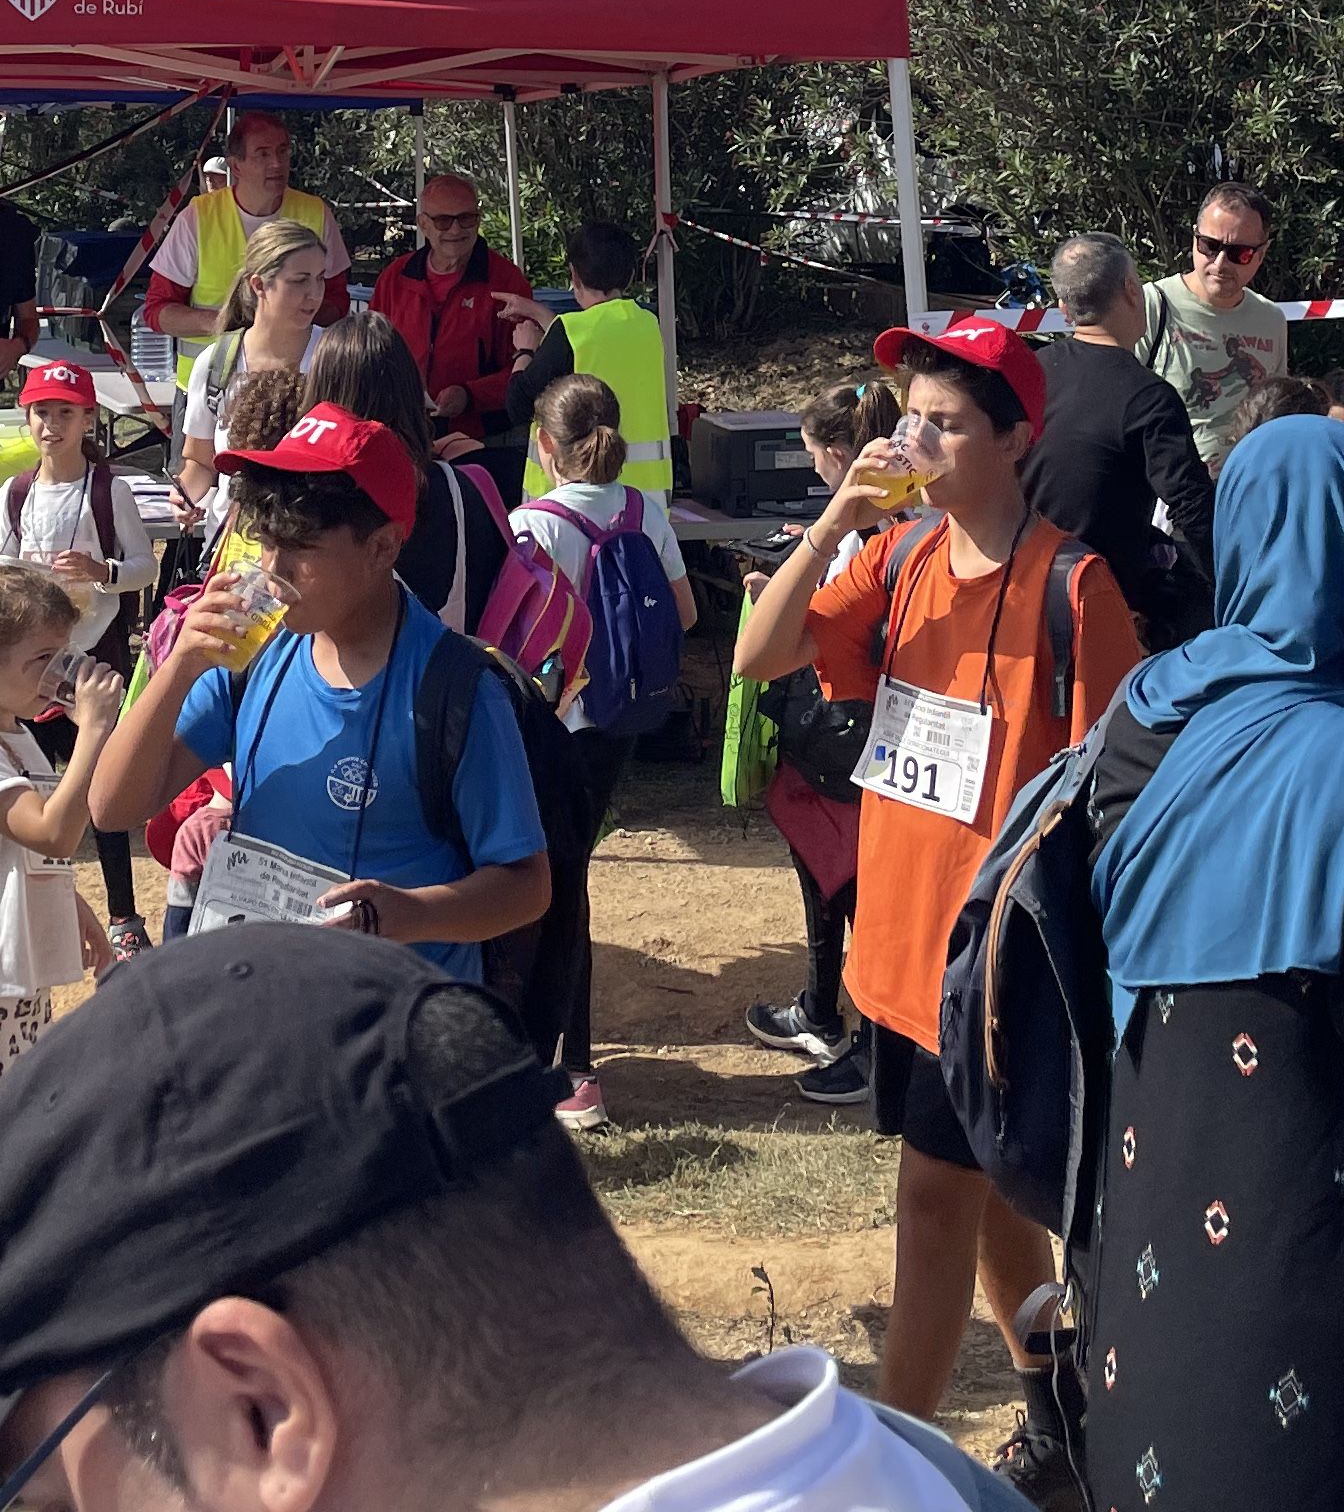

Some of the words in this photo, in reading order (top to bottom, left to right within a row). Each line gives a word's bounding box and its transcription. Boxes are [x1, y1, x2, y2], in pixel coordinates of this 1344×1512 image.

[43, 366, 80, 385] TOT
[283, 417, 337, 445] OT
[882, 749, 941, 803] 191
